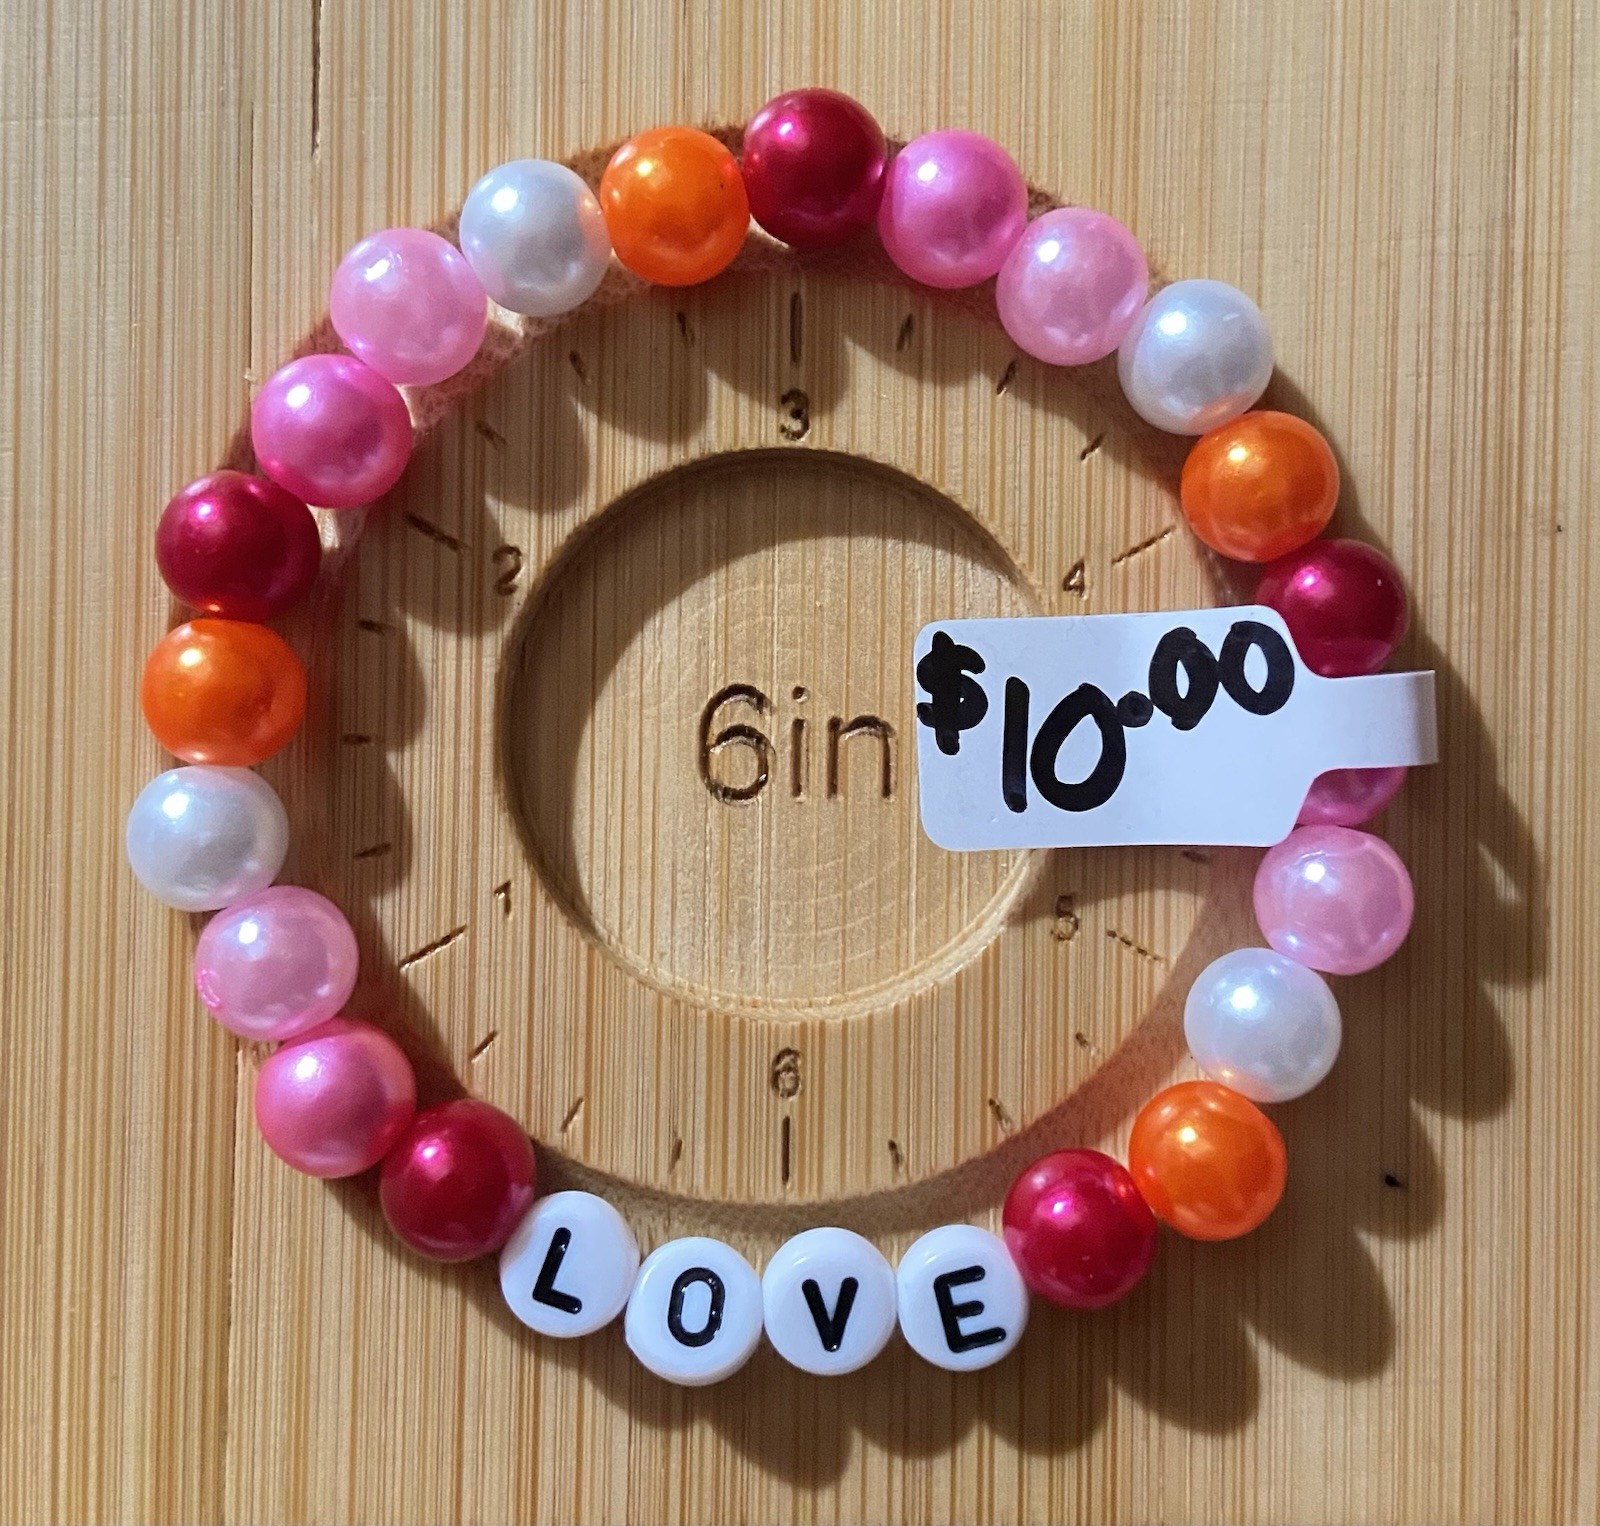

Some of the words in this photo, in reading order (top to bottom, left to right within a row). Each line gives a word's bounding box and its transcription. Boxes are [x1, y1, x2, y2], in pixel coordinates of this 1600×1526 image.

[779, 388, 811, 441] 3
[492, 545, 523, 595] 2
[1063, 560, 1089, 600] 4
[699, 683, 897, 801] 6in
[916, 621, 1295, 813] $10.00
[493, 880, 512, 917] 1
[1050, 895, 1080, 942] 5
[770, 1047, 802, 1099] 6
[532, 1227, 1007, 1354] LOVE
